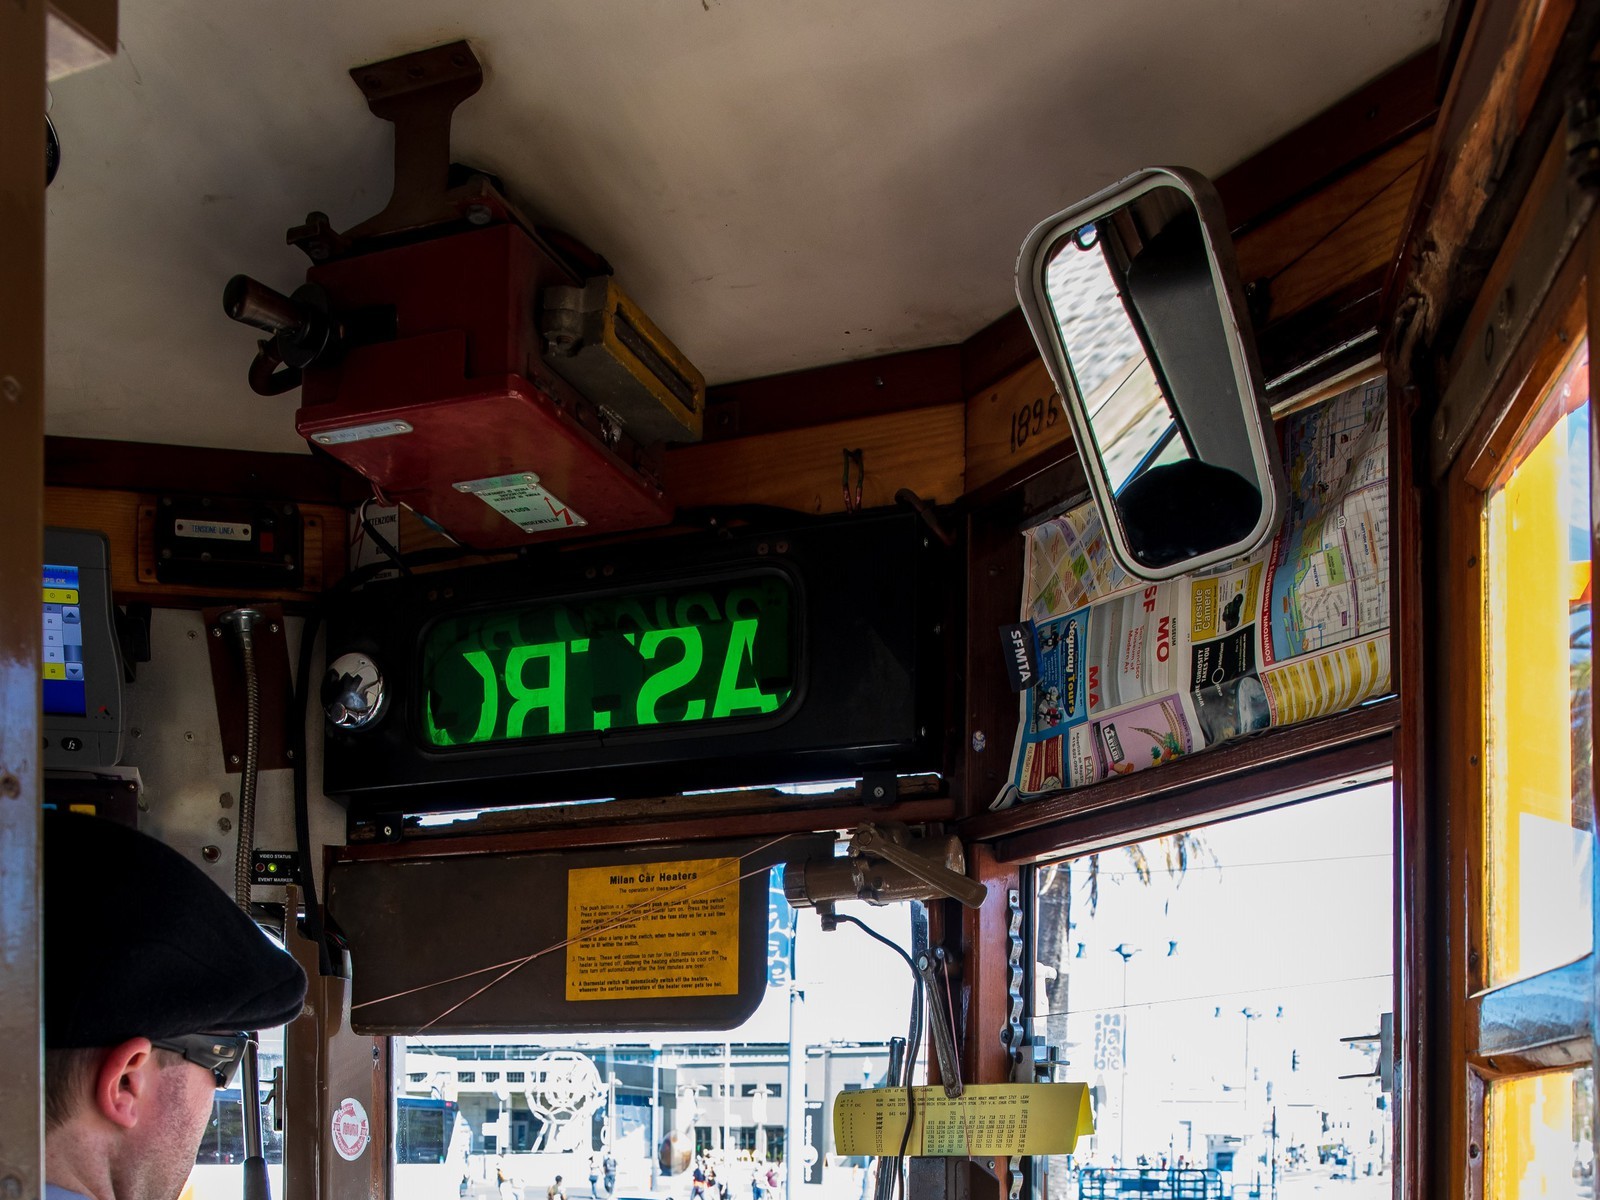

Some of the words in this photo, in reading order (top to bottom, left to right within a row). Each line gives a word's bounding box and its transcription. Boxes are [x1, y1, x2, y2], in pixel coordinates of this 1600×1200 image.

[366, 514, 397, 526] TTENZIONE
[1143, 585, 1158, 613] SF
[1194, 589, 1203, 633] Fireside
[1202, 589, 1211, 629] Camera
[1010, 630, 1032, 683] SFMTA
[1066, 620, 1077, 673] Segway
[1157, 616, 1169, 663] MO
[1195, 649, 1204, 683] CURIOSITY
[1201, 661, 1209, 683] TAKES
[1066, 673, 1076, 715] Tours
[1089, 666, 1099, 709] MA
[609, 875, 634, 885] Milan
[638, 873, 655, 883] Car
[659, 871, 697, 881] Heaters
